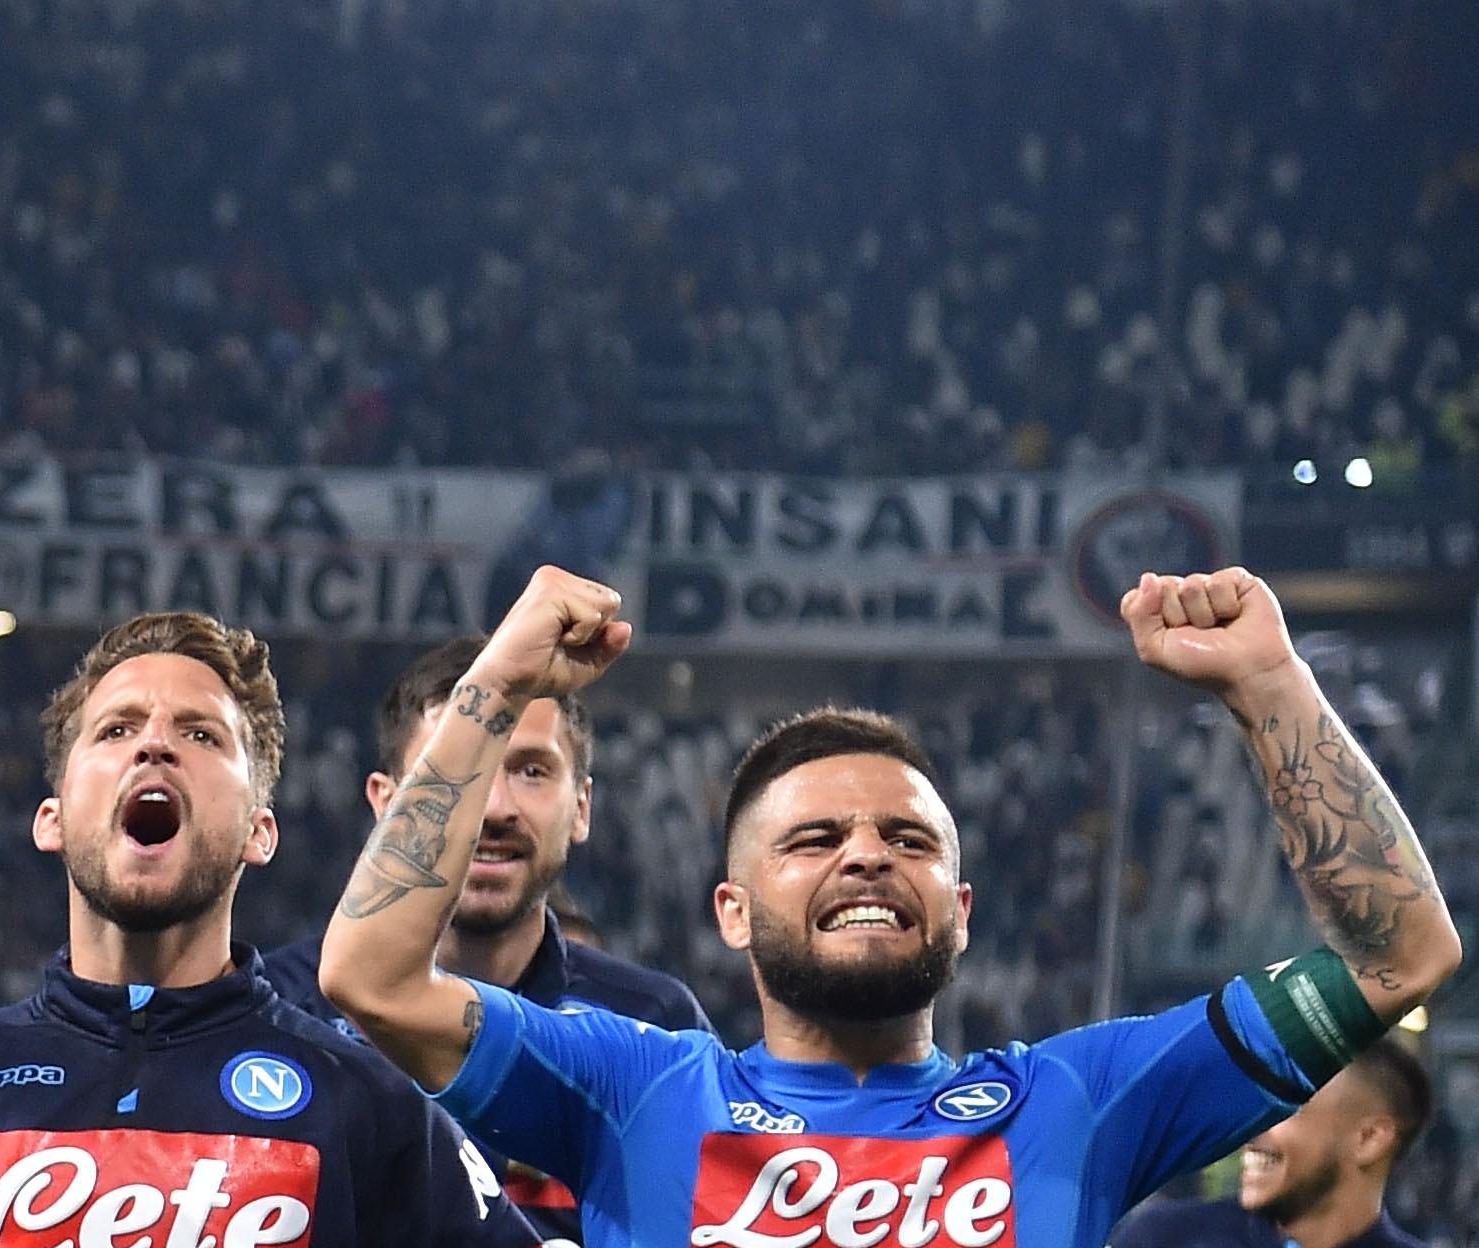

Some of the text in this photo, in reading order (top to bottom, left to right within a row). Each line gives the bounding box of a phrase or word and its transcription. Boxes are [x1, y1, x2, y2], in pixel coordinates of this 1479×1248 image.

[648, 488, 1057, 556] INSANI
[40, 542, 460, 626] FRANCIA
[250, 1067, 290, 1100] N
[944, 1087, 998, 1116] N
